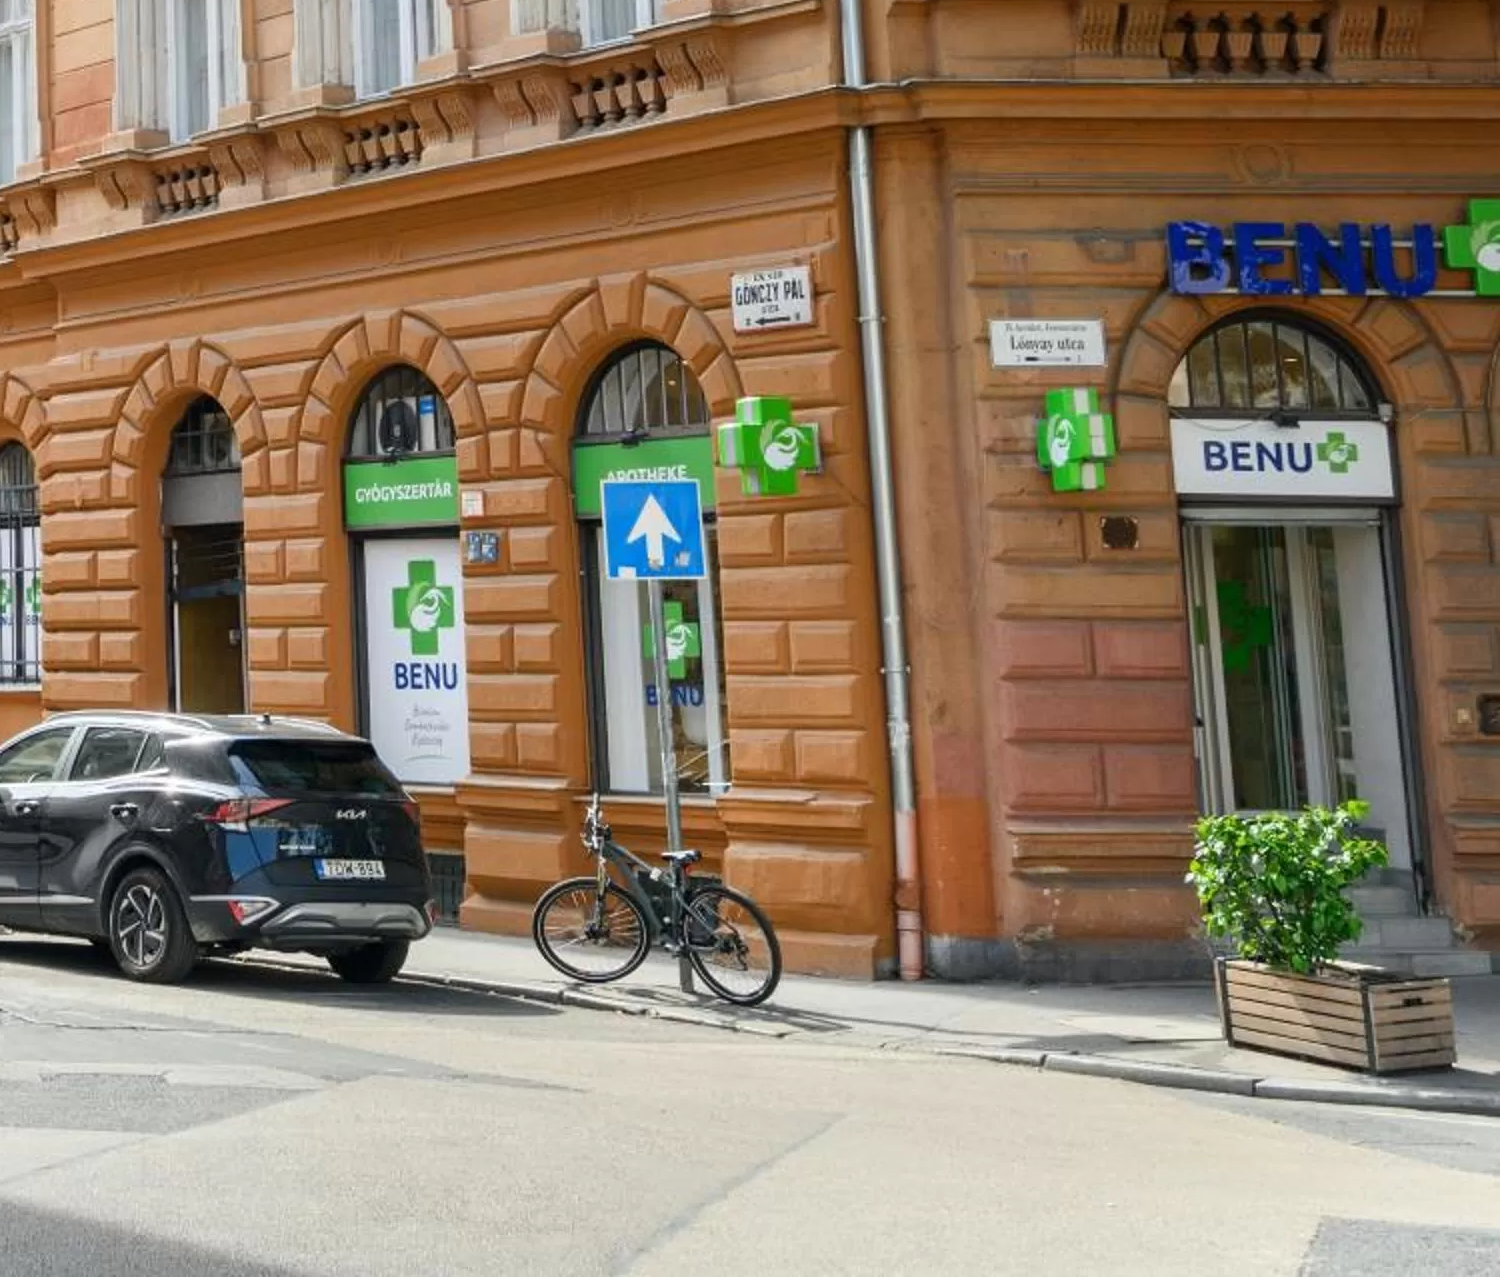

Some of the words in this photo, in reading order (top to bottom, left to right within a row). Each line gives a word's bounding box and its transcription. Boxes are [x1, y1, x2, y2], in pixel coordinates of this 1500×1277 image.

[1167, 221, 1438, 300] BENU
[1010, 334, 1054, 354] Lónyay
[1056, 337, 1085, 351] utca
[1202, 440, 1313, 473] BENU
[606, 464, 688, 482] APOTHEKE
[355, 478, 453, 504] GYÓGYSZERTÁR
[394, 662, 458, 690] BENU
[646, 683, 705, 707] BNU
